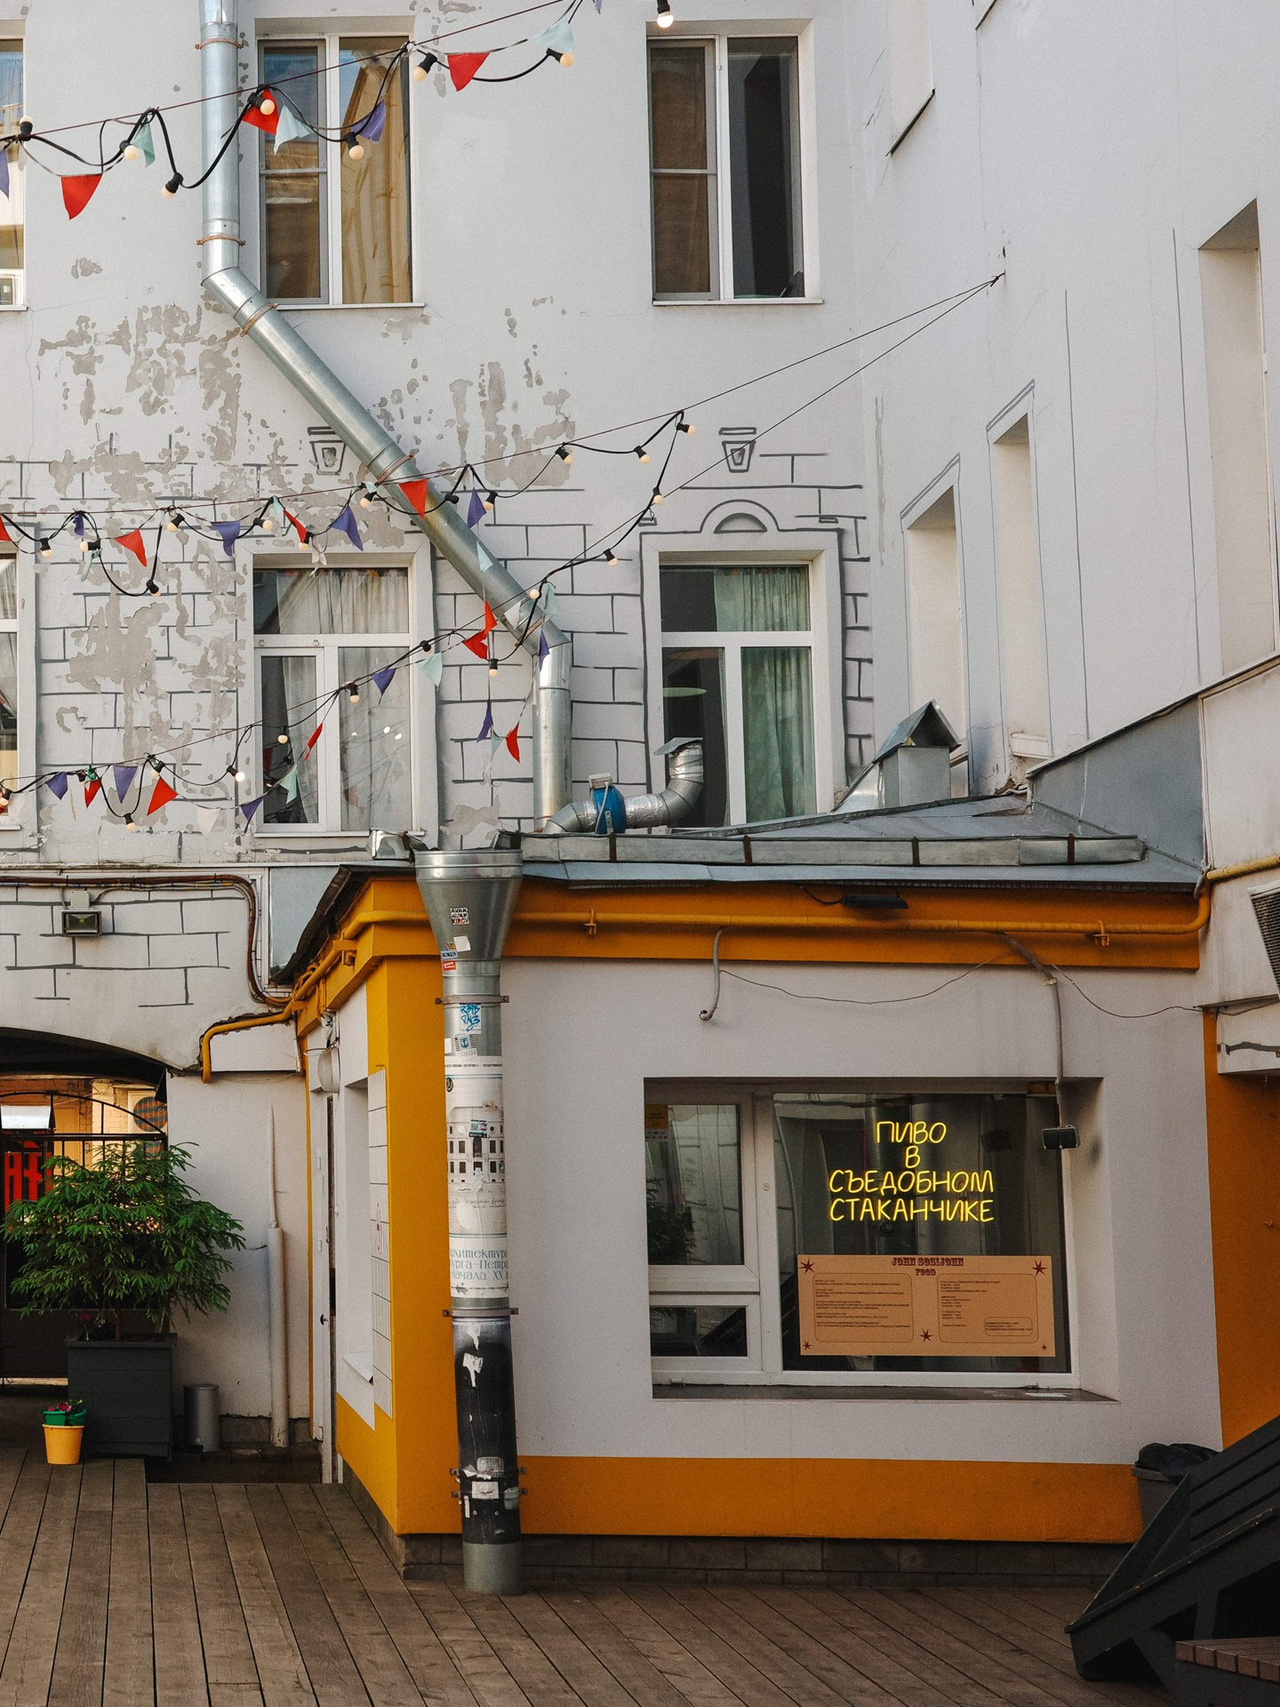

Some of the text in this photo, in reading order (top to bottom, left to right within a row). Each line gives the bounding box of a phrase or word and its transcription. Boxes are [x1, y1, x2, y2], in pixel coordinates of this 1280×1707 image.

[876, 1121, 947, 1144] ПИВО
[905, 1145, 921, 1169] В
[829, 1169, 994, 1196] СЪЕДОБНОМ
[829, 1198, 995, 1222] СТАКАНЧИКЕ
[891, 1257, 916, 1266] JOHN
[915, 1268, 936, 1276] FOOD
